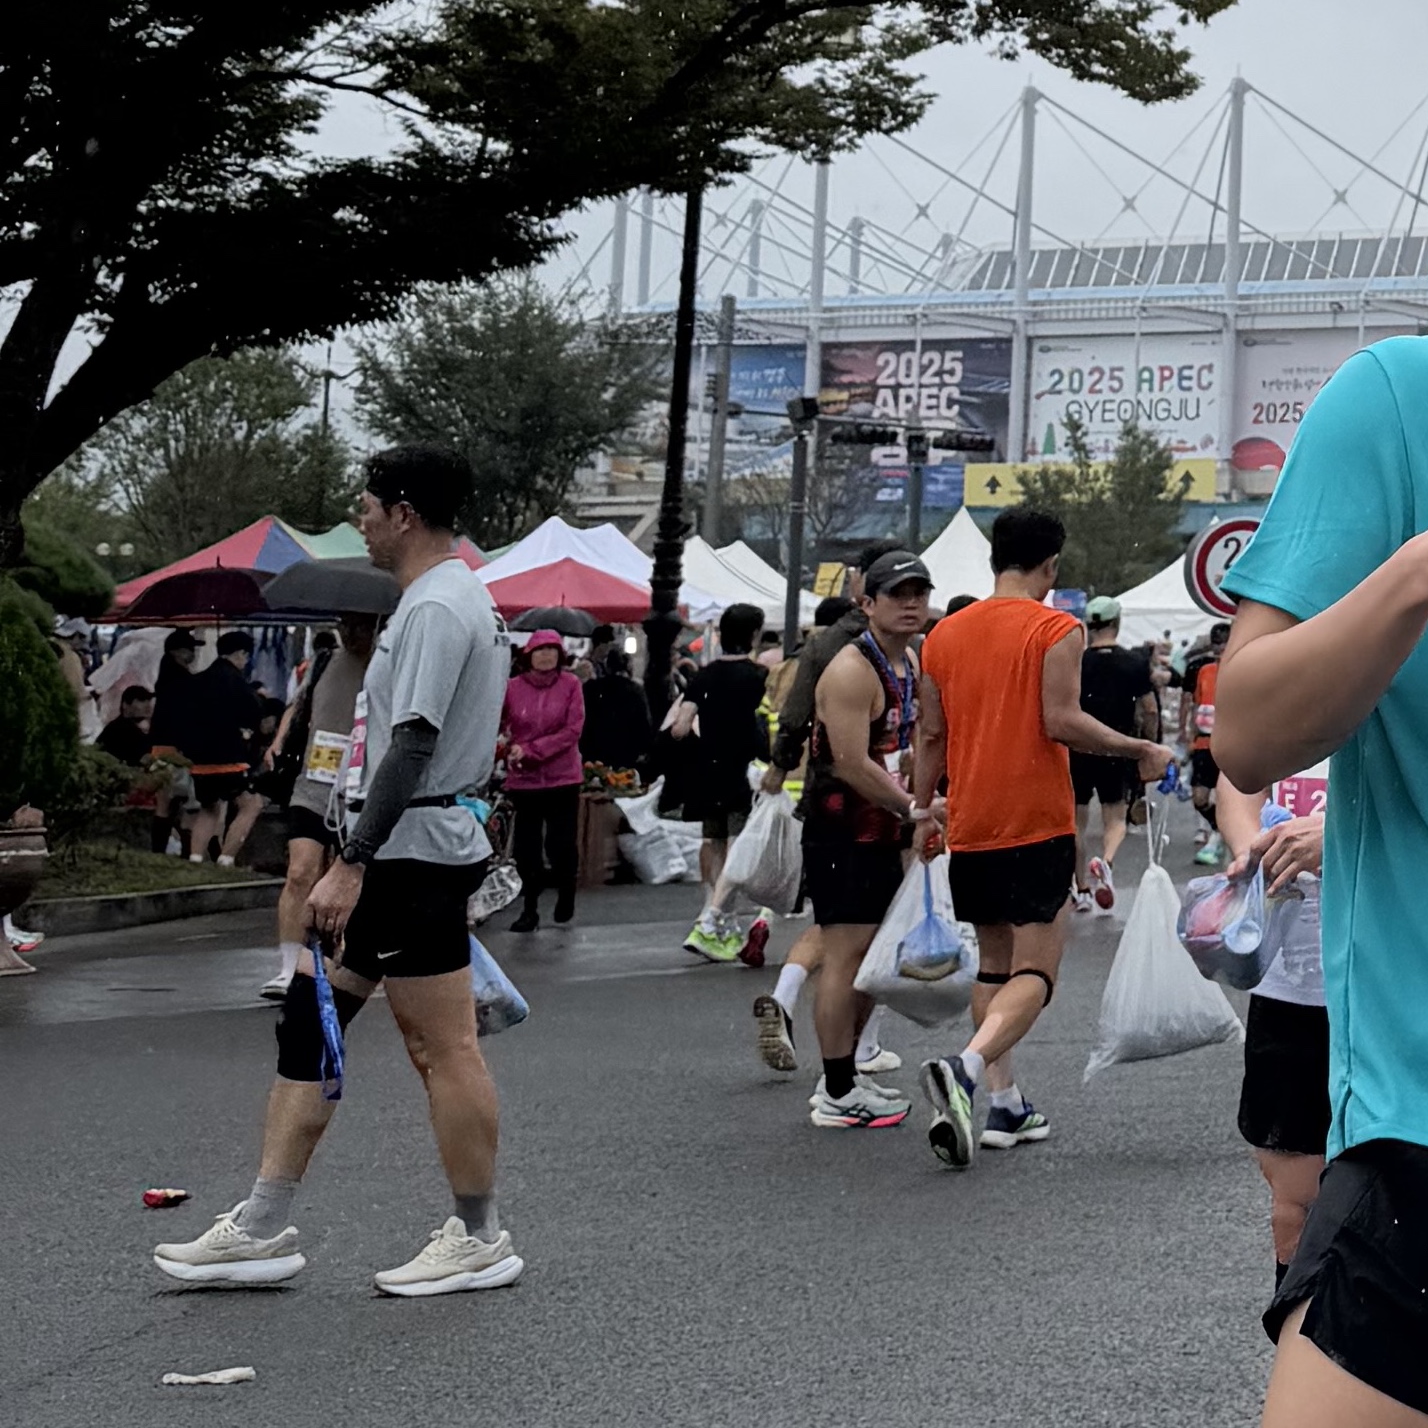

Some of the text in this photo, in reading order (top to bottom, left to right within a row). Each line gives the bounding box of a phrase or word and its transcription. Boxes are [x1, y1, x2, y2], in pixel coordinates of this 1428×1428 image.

[876, 351, 963, 384] 2025
[1050, 363, 1214, 395] 2025 APEC
[871, 386, 960, 418] APEC
[1065, 398, 1201, 422] GYEONGJU
[1252, 401, 1304, 425] 2025
[1224, 536, 1250, 570] 2
